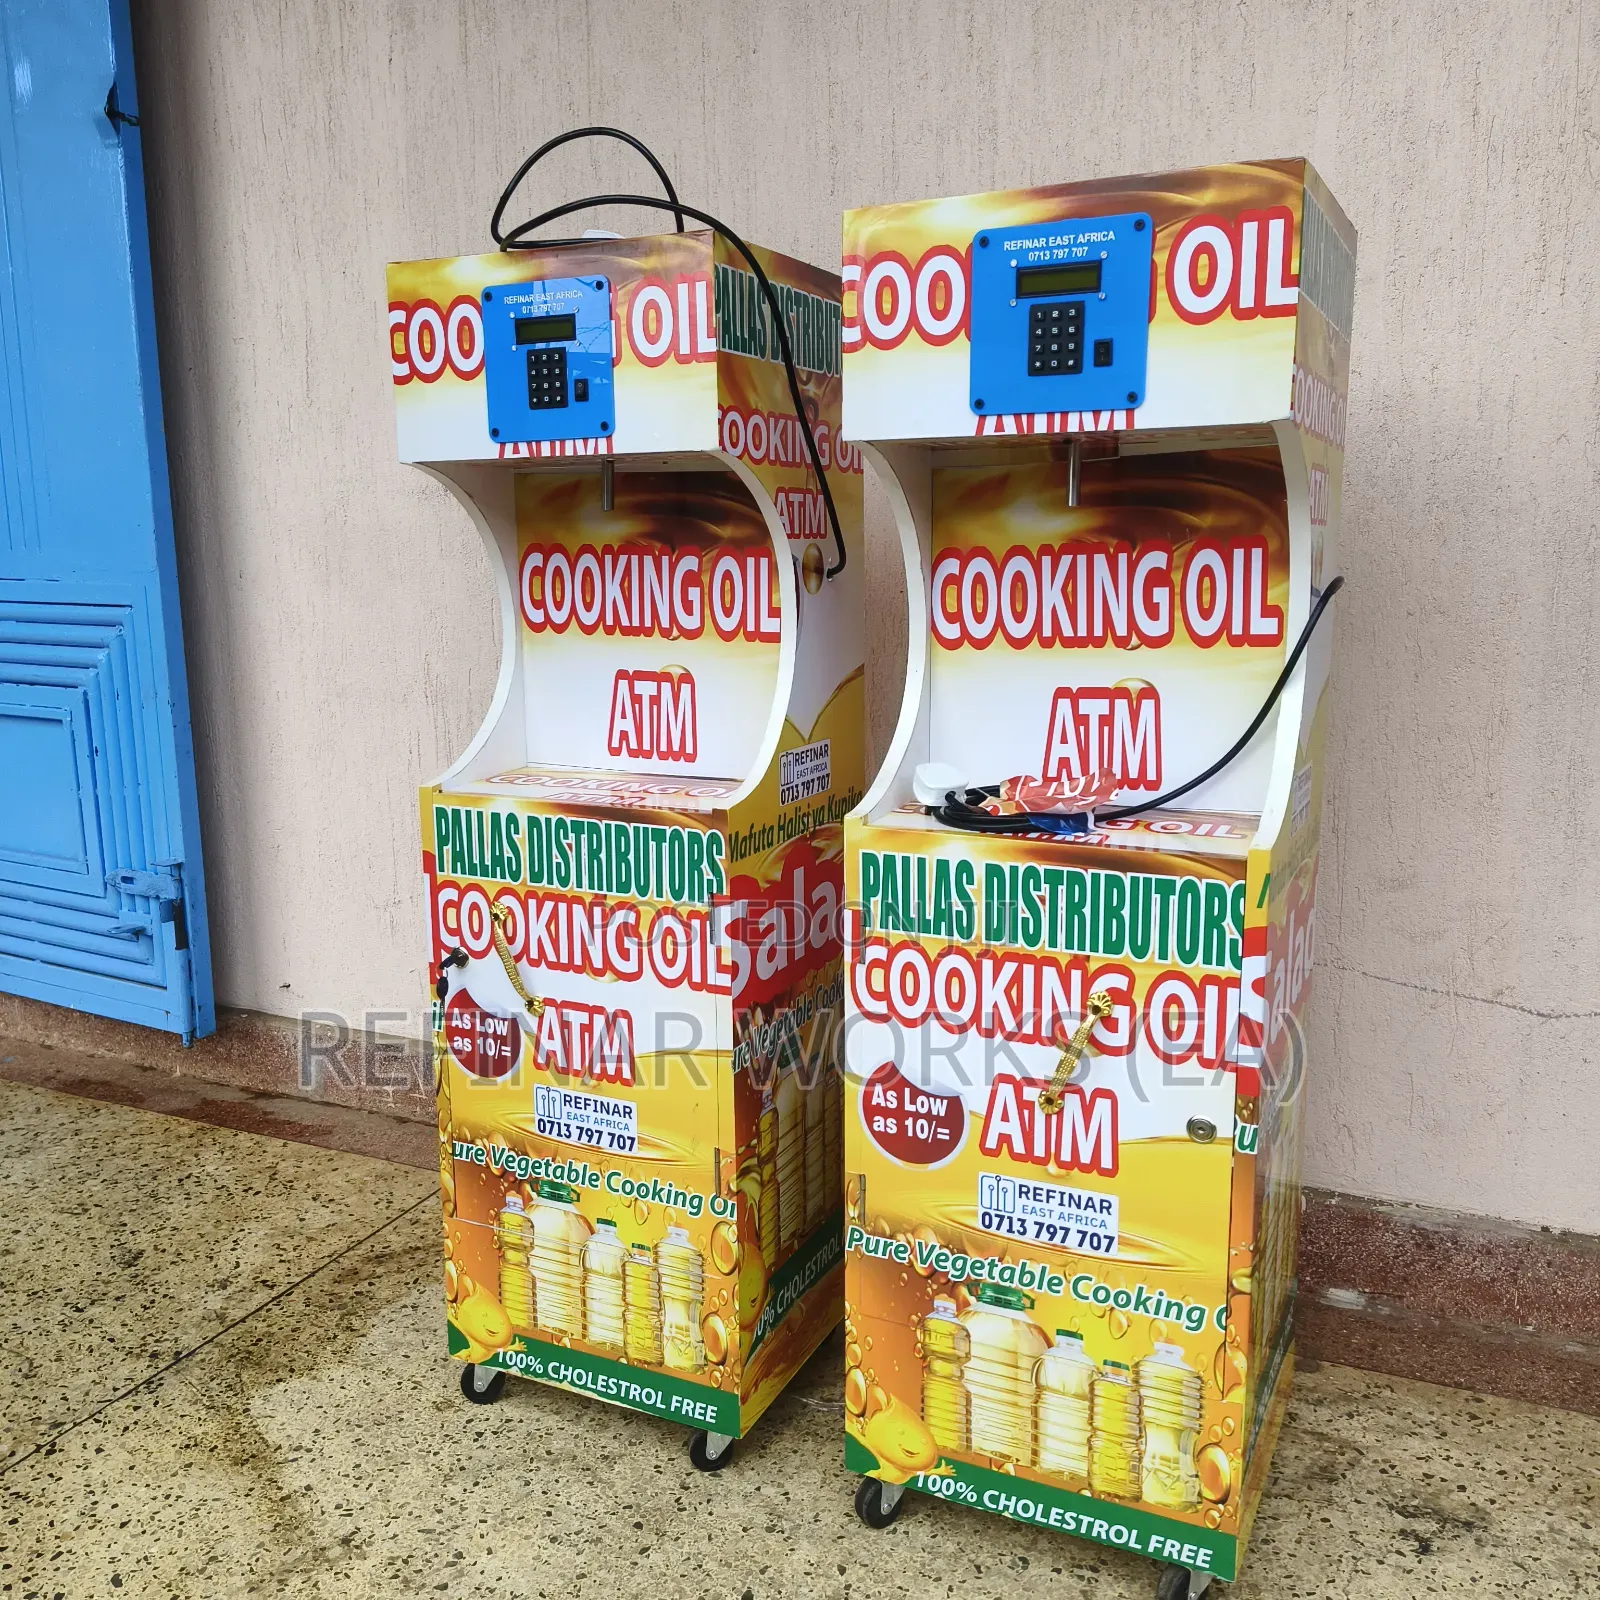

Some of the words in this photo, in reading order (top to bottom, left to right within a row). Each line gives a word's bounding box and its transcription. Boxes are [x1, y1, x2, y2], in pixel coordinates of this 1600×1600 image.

[1003, 237, 1047, 251] REFINAR
[1049, 234, 1075, 247] EAST
[1076, 231, 1115, 244] AFRICA
[1028, 250, 1050, 262] 0713
[1052, 248, 1068, 260] 797
[1072, 246, 1089, 258] 707
[1167, 206, 1299, 324] OIL
[504, 294, 535, 305] REFINAR
[536, 292, 555, 302] EAST
[556, 290, 583, 300] AFRICA
[522, 304, 538, 315] 0713
[540, 303, 552, 313] 797
[553, 302, 565, 312] 707
[629, 272, 717, 367] OIL
[1290, 364, 1336, 444] OOKING
[718, 403, 832, 472] OOKING
[774, 487, 828, 540] ATM
[519, 543, 701, 641] COOKING
[702, 546, 781, 643] OIL
[931, 542, 1174, 651] COOKING
[1181, 535, 1284, 648] OIL
[607, 669, 698, 762] ATM
[1041, 686, 1163, 792] ATM
[795, 743, 829, 767] REFINAR
[796, 768, 809, 780] EAST
[486, 774, 680, 797] COOKING
[780, 783, 800, 805] 0713
[800, 778, 815, 797] 797
[816, 772, 831, 791] 707
[811, 804, 825, 835] ya
[1144, 819, 1249, 840] OIL
[433, 805, 523, 883] PALLAS
[526, 816, 725, 904] DISTRIBUTORS
[715, 866, 845, 999] Sala
[859, 850, 977, 941] PALLAS
[981, 862, 1245, 969] DISTRIBUTORS
[436, 880, 645, 982] COOKING
[646, 906, 732, 996] OIL
[450, 1008, 471, 1030] As
[852, 937, 1135, 1057] COOKING
[453, 1038, 472, 1053] as
[533, 998, 634, 1087] ATM
[563, 1093, 633, 1120] REFINAR
[567, 1111, 591, 1124] EAST
[593, 1117, 630, 1132] AFRICA
[871, 1082, 897, 1109] As
[537, 1118, 572, 1139] 0713
[576, 1126, 604, 1145] 797
[607, 1132, 636, 1152] 707
[872, 1114, 897, 1135] as
[905, 1116, 950, 1143] 10/=
[979, 1073, 1119, 1178] ATM
[490, 1143, 600, 1189] Vegetable
[605, 1171, 704, 1216] Cooking
[1018, 1183, 1113, 1216] REFINAR
[981, 1211, 1027, 1236] 0713
[1033, 1220, 1071, 1244] 797
[1076, 1229, 1116, 1253] 707
[1022, 1204, 1055, 1219] EAST
[1057, 1211, 1108, 1230] AFRICA
[776, 1233, 840, 1315] CHOLESTROL
[847, 1226, 910, 1265] Pure
[915, 1241, 1064, 1296] Vegetable
[1070, 1274, 1208, 1334] Cooking
[496, 1347, 544, 1376] 100%
[547, 1361, 668, 1411] CHOLESTROL
[669, 1395, 719, 1424] FREE
[915, 1471, 978, 1504] 100%
[982, 1488, 1144, 1551] CHOLESTROL
[1146, 1534, 1214, 1569] FREE
